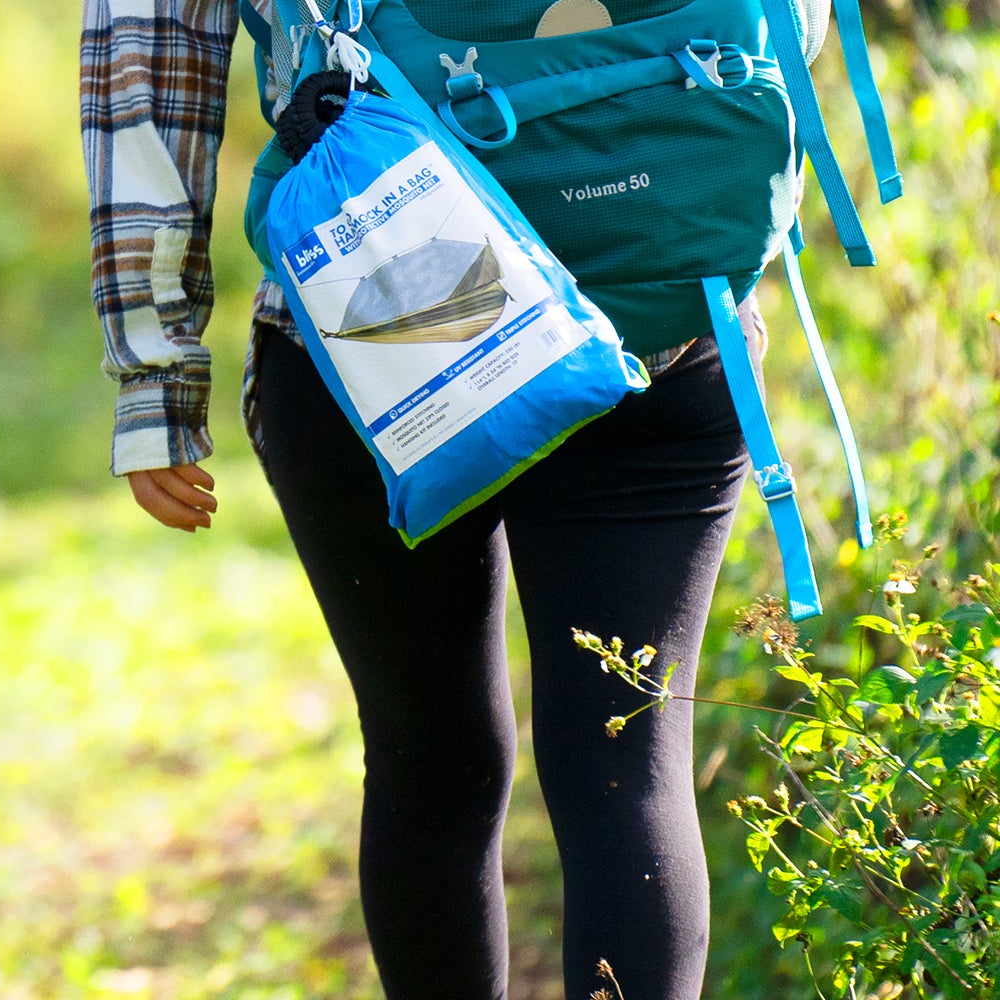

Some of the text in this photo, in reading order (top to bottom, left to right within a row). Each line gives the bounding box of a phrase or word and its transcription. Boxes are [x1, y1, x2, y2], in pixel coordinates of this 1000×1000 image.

[382, 192, 397, 207] IN
[398, 185, 408, 195] A
[408, 167, 432, 187] BAG
[388, 187, 424, 214] MOSQUITO
[423, 177, 437, 191] NET
[560, 172, 650, 202] Volume 50
[329, 224, 346, 239] TO
[295, 244, 324, 268] bliss
